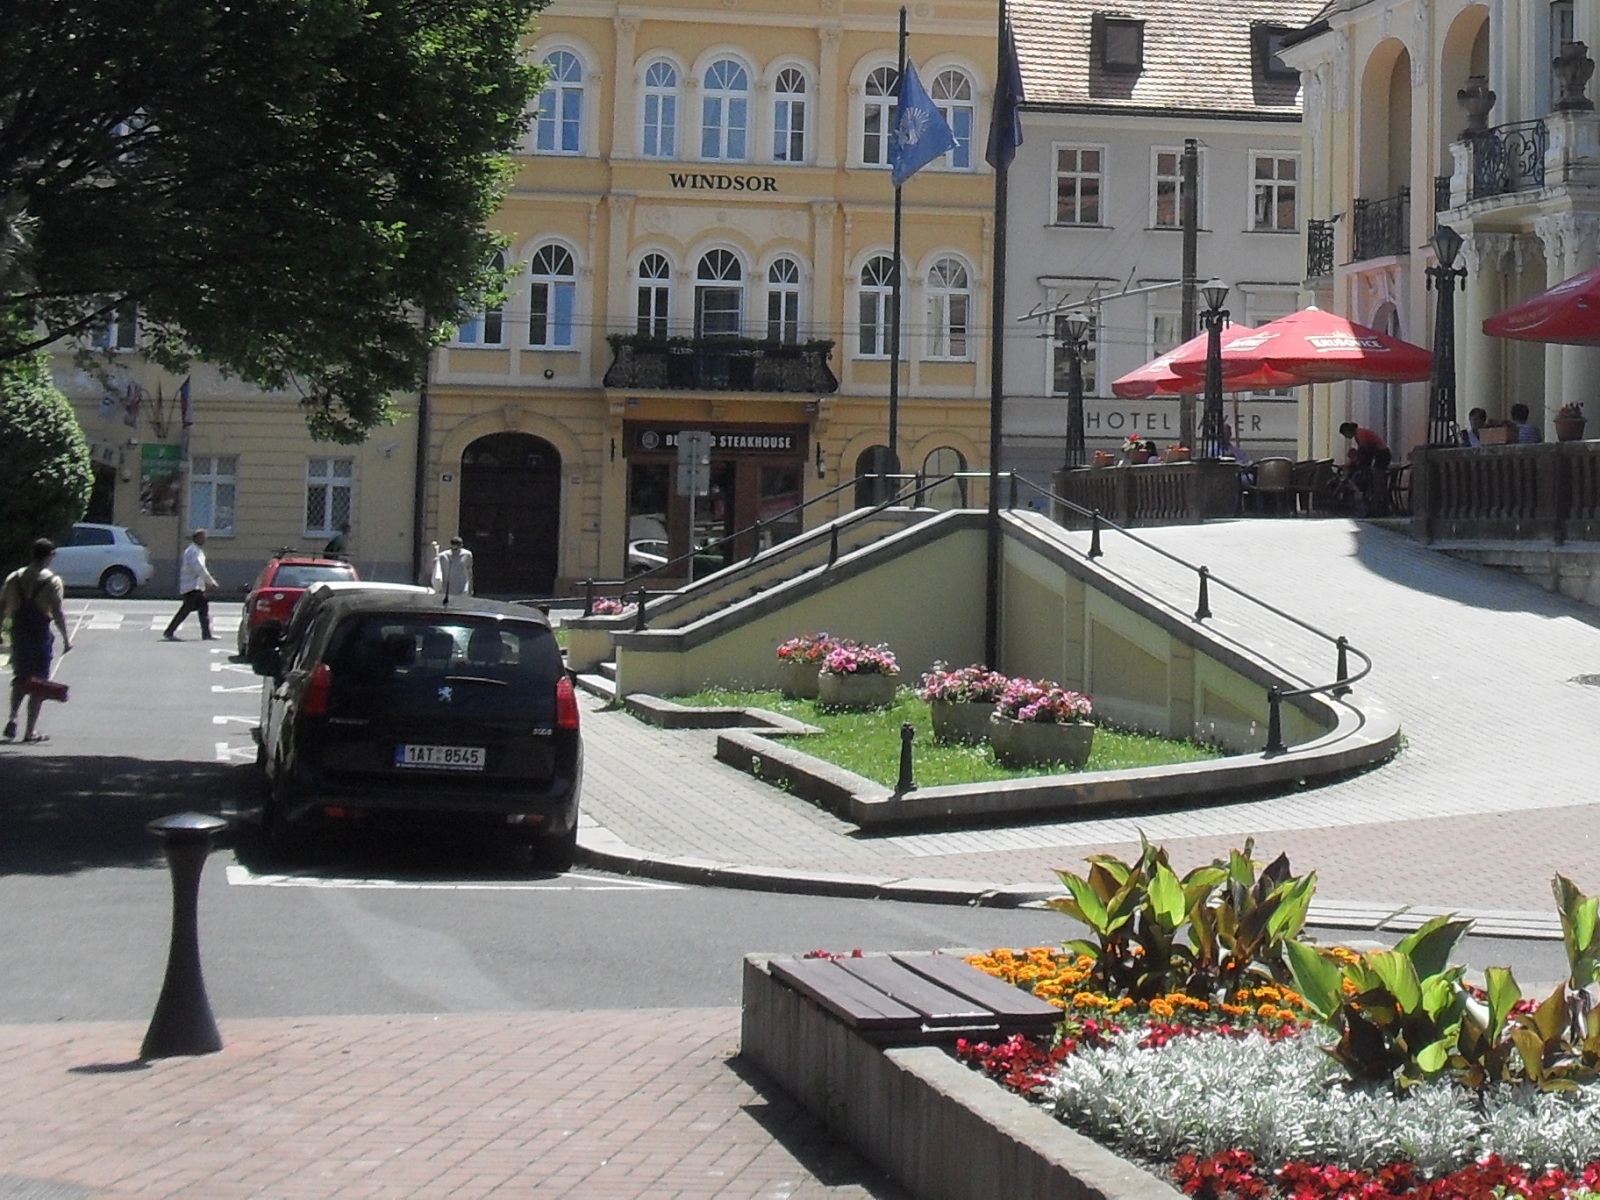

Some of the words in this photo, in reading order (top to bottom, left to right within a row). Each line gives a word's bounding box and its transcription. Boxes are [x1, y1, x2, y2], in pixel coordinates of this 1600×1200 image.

[668, 172, 779, 192] WINDSOR
[1086, 411, 1171, 430] HOTEL
[719, 434, 791, 449] STEAKHOUSE
[409, 747, 434, 762] 1AT
[444, 748, 480, 764] 8545
